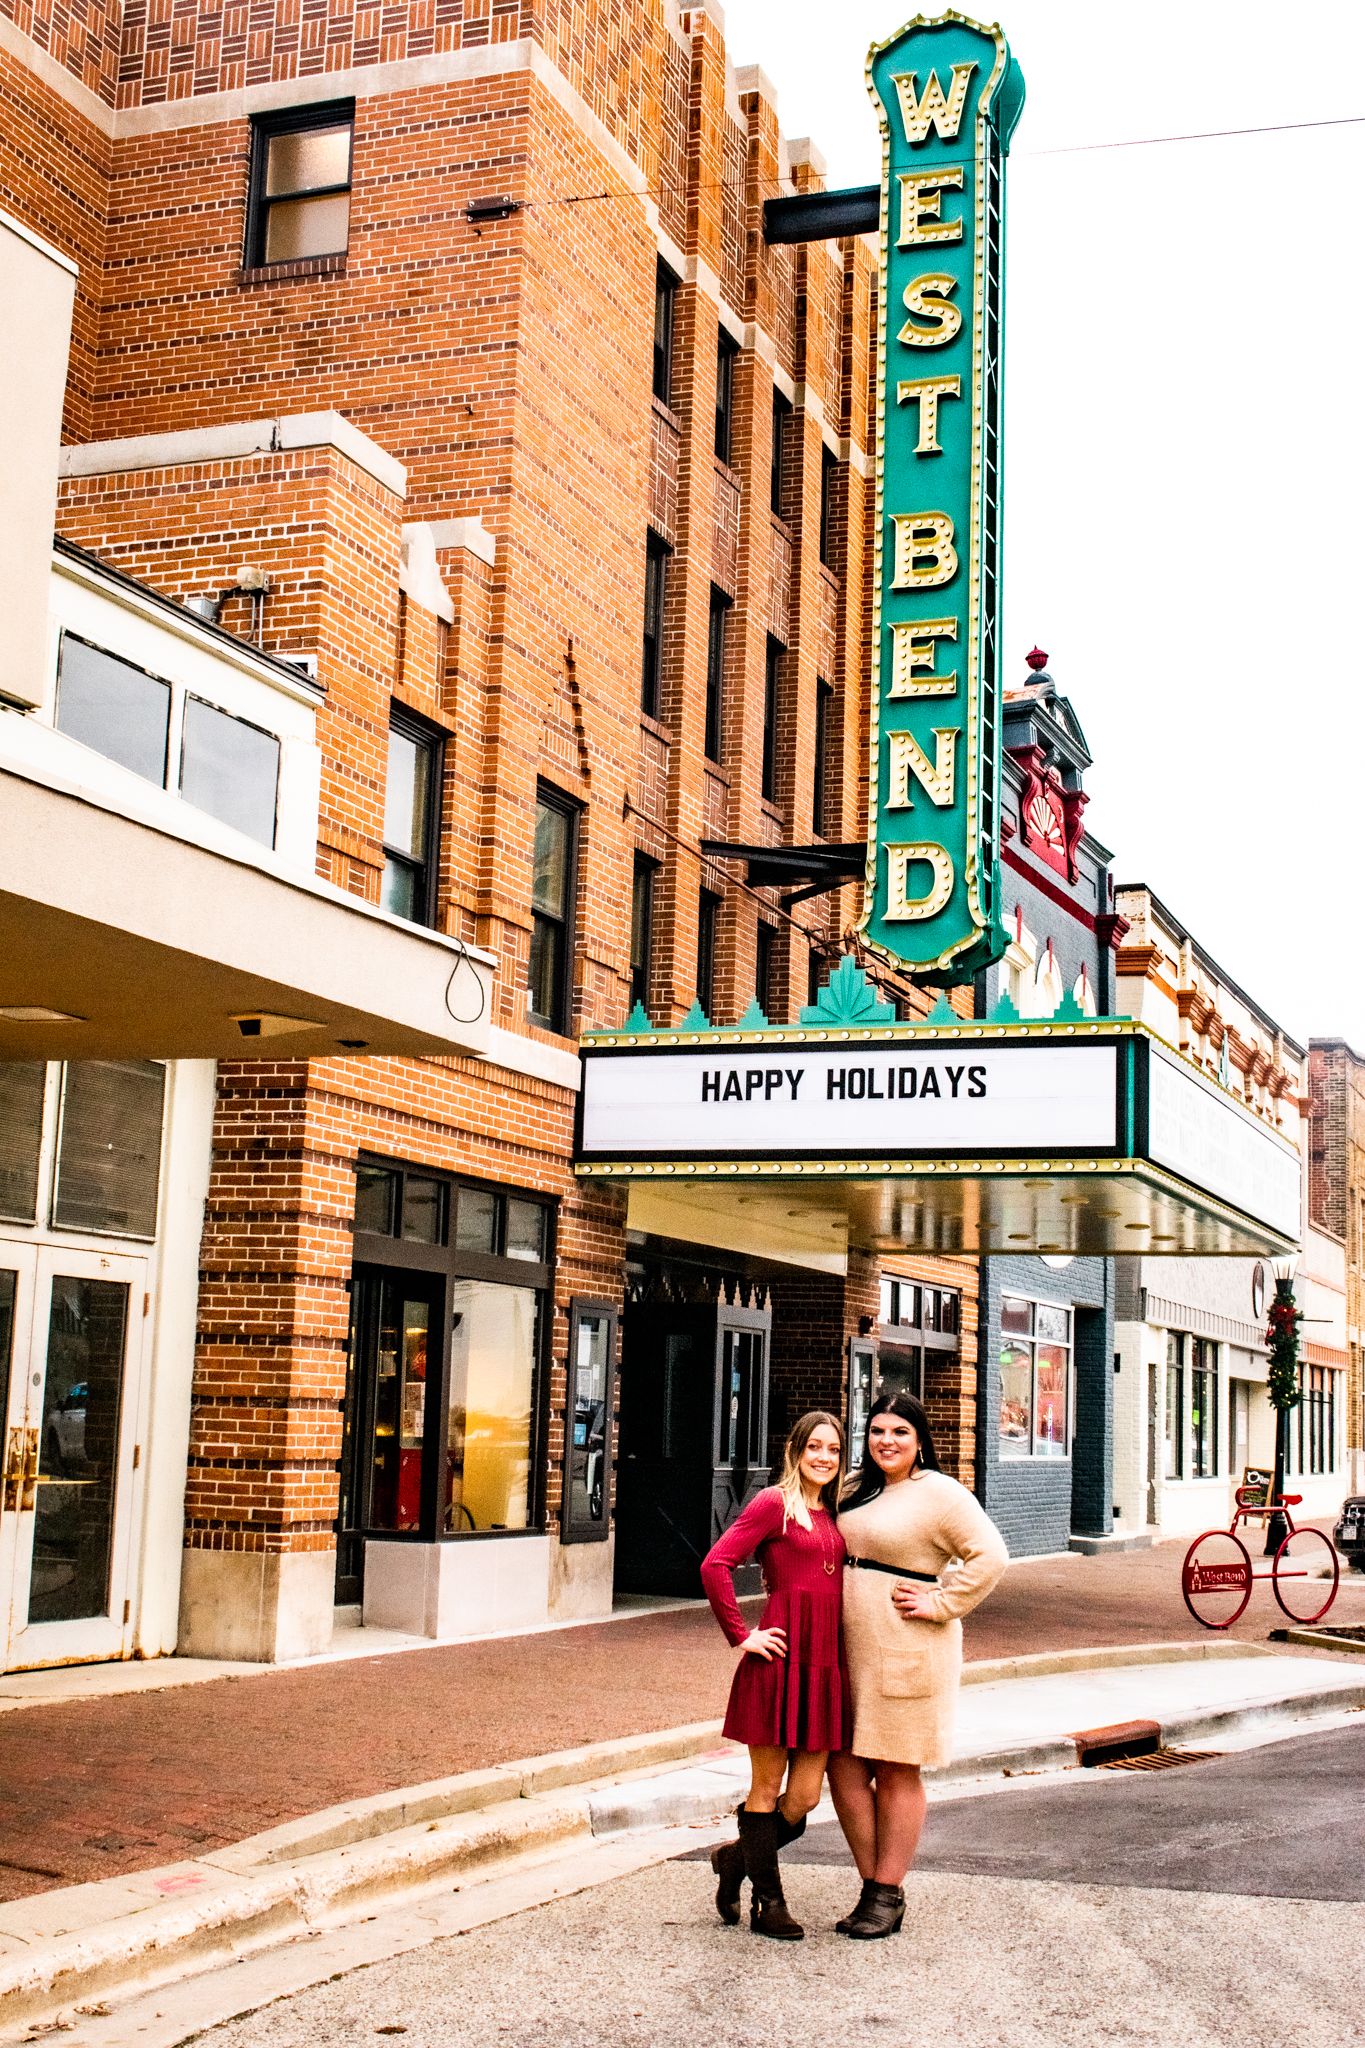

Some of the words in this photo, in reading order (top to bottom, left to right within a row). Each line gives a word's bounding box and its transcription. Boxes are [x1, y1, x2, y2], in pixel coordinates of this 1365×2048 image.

[890, 61, 979, 453] WEST
[881, 511, 960, 921] BEND
[701, 1069, 804, 1102] HAPPY
[826, 1065, 987, 1100] HOLIDAYS
[1202, 1571, 1223, 1583] West
[1224, 1568, 1246, 1582] Bend
